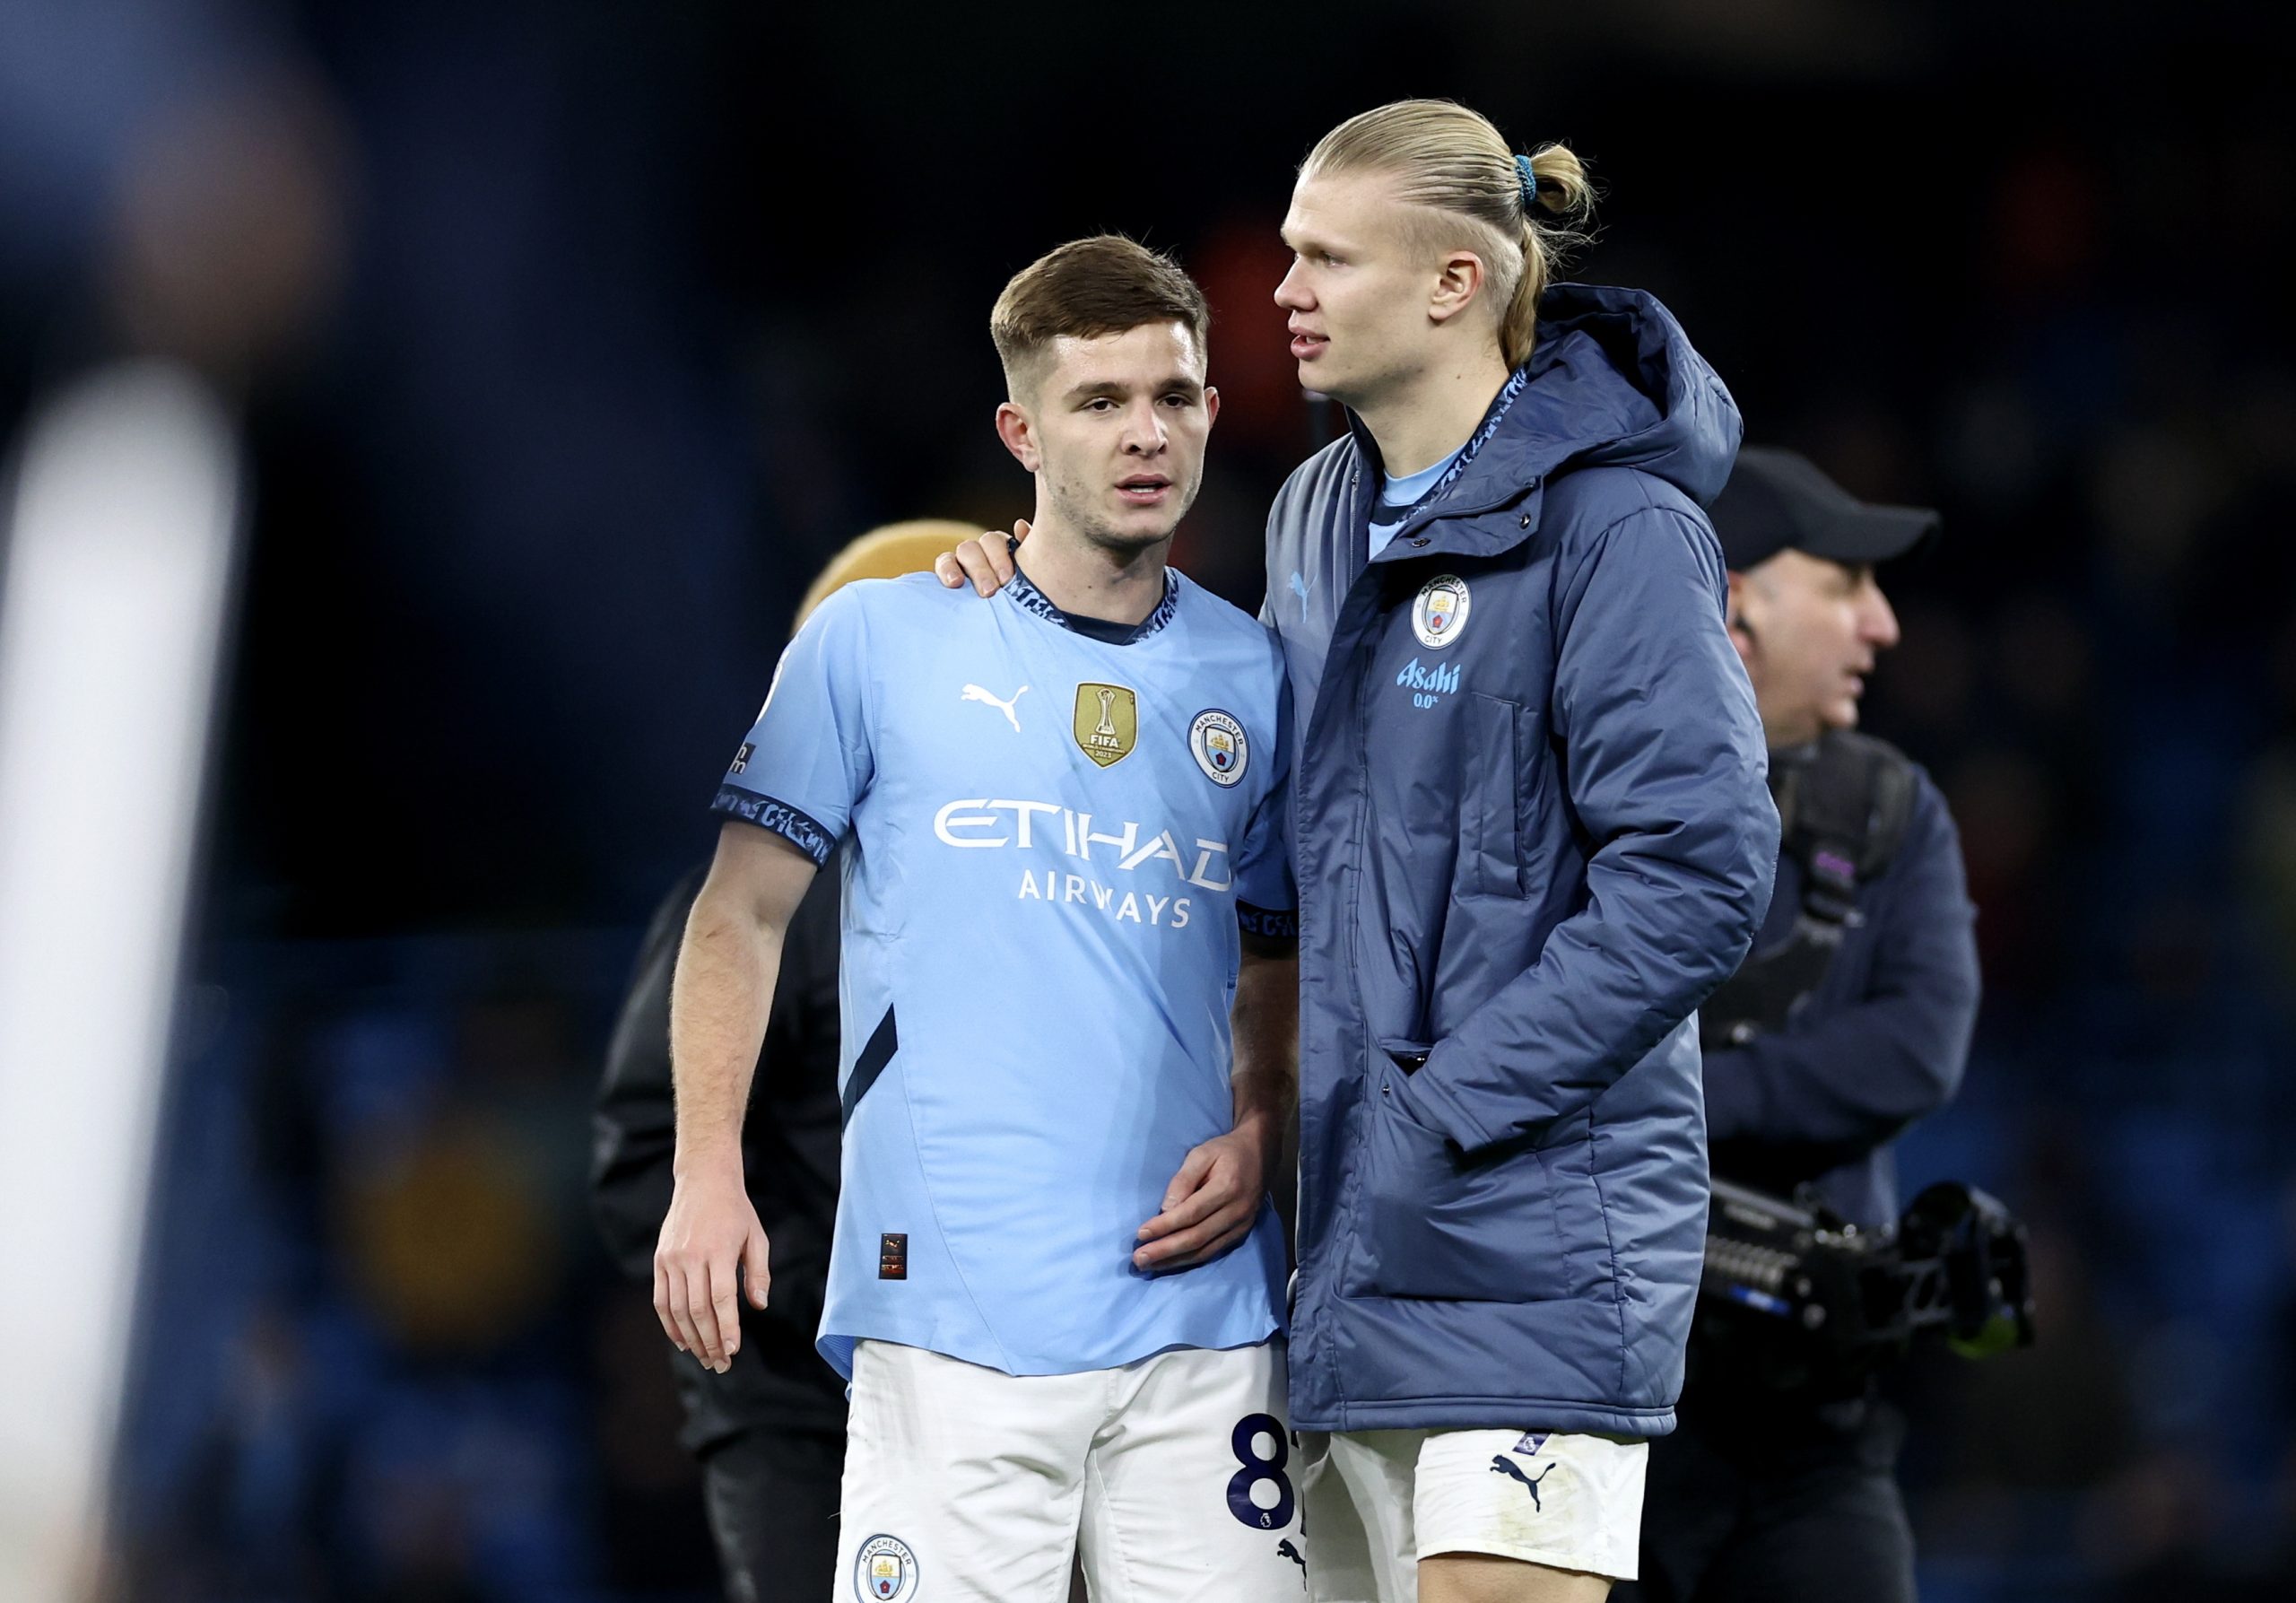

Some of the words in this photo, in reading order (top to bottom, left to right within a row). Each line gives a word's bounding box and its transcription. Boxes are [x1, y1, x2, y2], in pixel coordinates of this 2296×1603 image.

[1421, 575, 1466, 604] MANCHESTER
[1424, 635, 1443, 644] CITY
[1396, 657, 1461, 694] Asahi
[1090, 734, 1119, 748] FIFA
[1196, 715, 1244, 745] MANCHESTER
[1095, 750, 1112, 759] 2023
[1212, 771, 1230, 782] CITY
[934, 798, 1233, 892] ETIHAD
[1018, 868, 1191, 928] AIRWAYS
[863, 1539, 912, 1566] MANCHESTER
